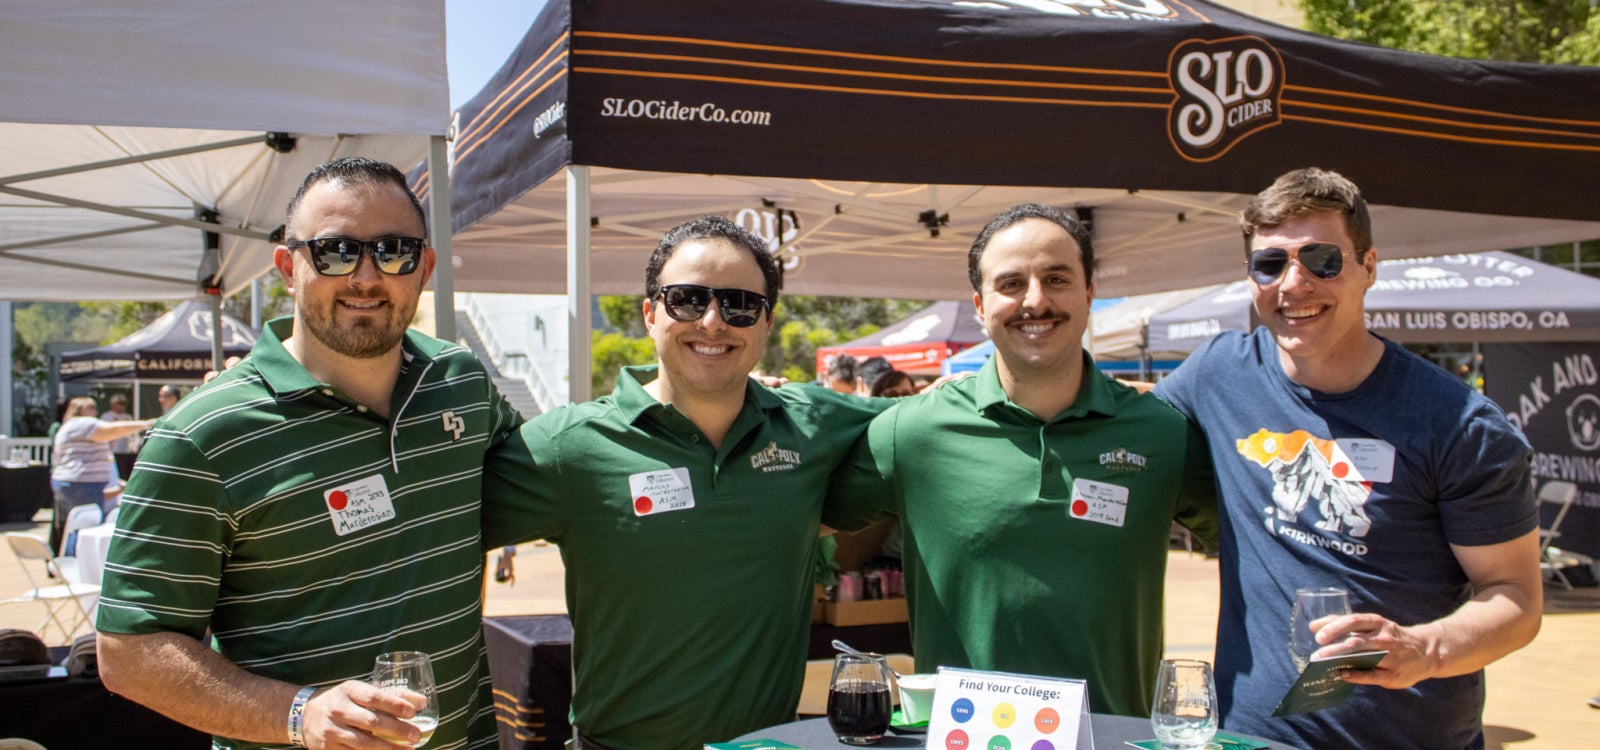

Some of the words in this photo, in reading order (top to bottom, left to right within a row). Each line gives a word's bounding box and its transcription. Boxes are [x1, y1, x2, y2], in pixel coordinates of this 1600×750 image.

[600, 97, 772, 126] SLOCiderCo.com
[1178, 48, 1273, 146] SLO
[1227, 99, 1273, 128] CIDER
[1364, 311, 1400, 329] SAN
[1405, 311, 1448, 330] LUIS
[1452, 311, 1534, 331] OBISPO,
[1538, 311, 1570, 329] CA
[1552, 353, 1598, 394] AND
[751, 450, 770, 468] CAL
[778, 449, 801, 465] POLY
[1099, 451, 1116, 465] CAL
[1127, 452, 1147, 467] POLY
[1279, 525, 1369, 556] KIRKWOOD
[959, 679, 983, 690] Find
[987, 682, 1012, 694] Your
[1013, 684, 1061, 700] College:
